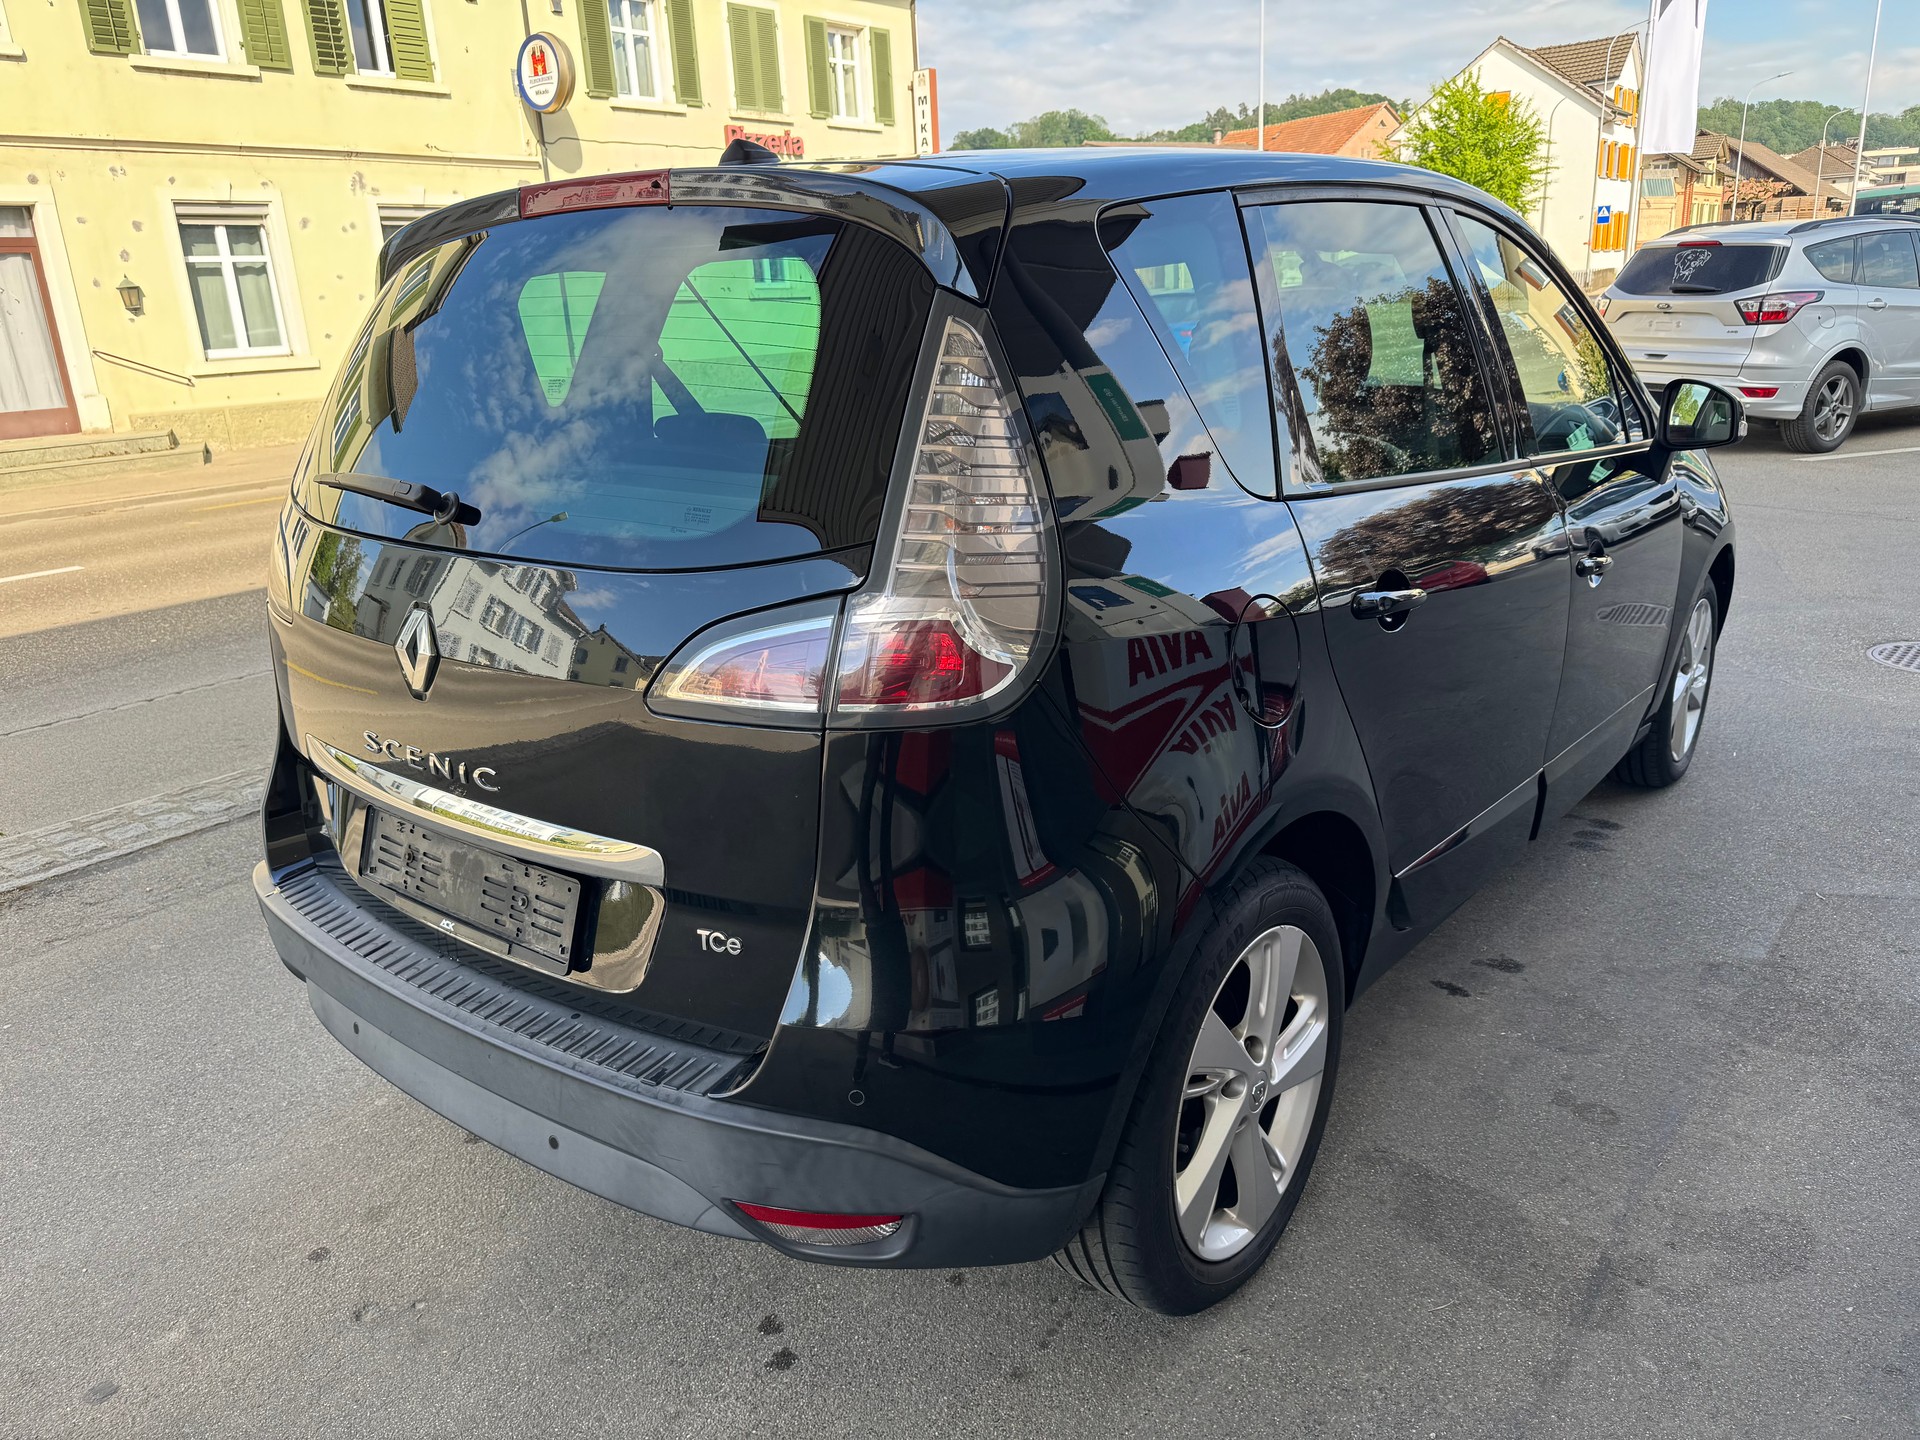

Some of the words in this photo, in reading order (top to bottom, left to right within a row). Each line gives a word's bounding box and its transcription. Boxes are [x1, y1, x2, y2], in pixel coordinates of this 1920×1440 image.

[918, 95, 929, 153] MIKA
[363, 730, 501, 792] SCENIC
[696, 928, 744, 956] TCe
